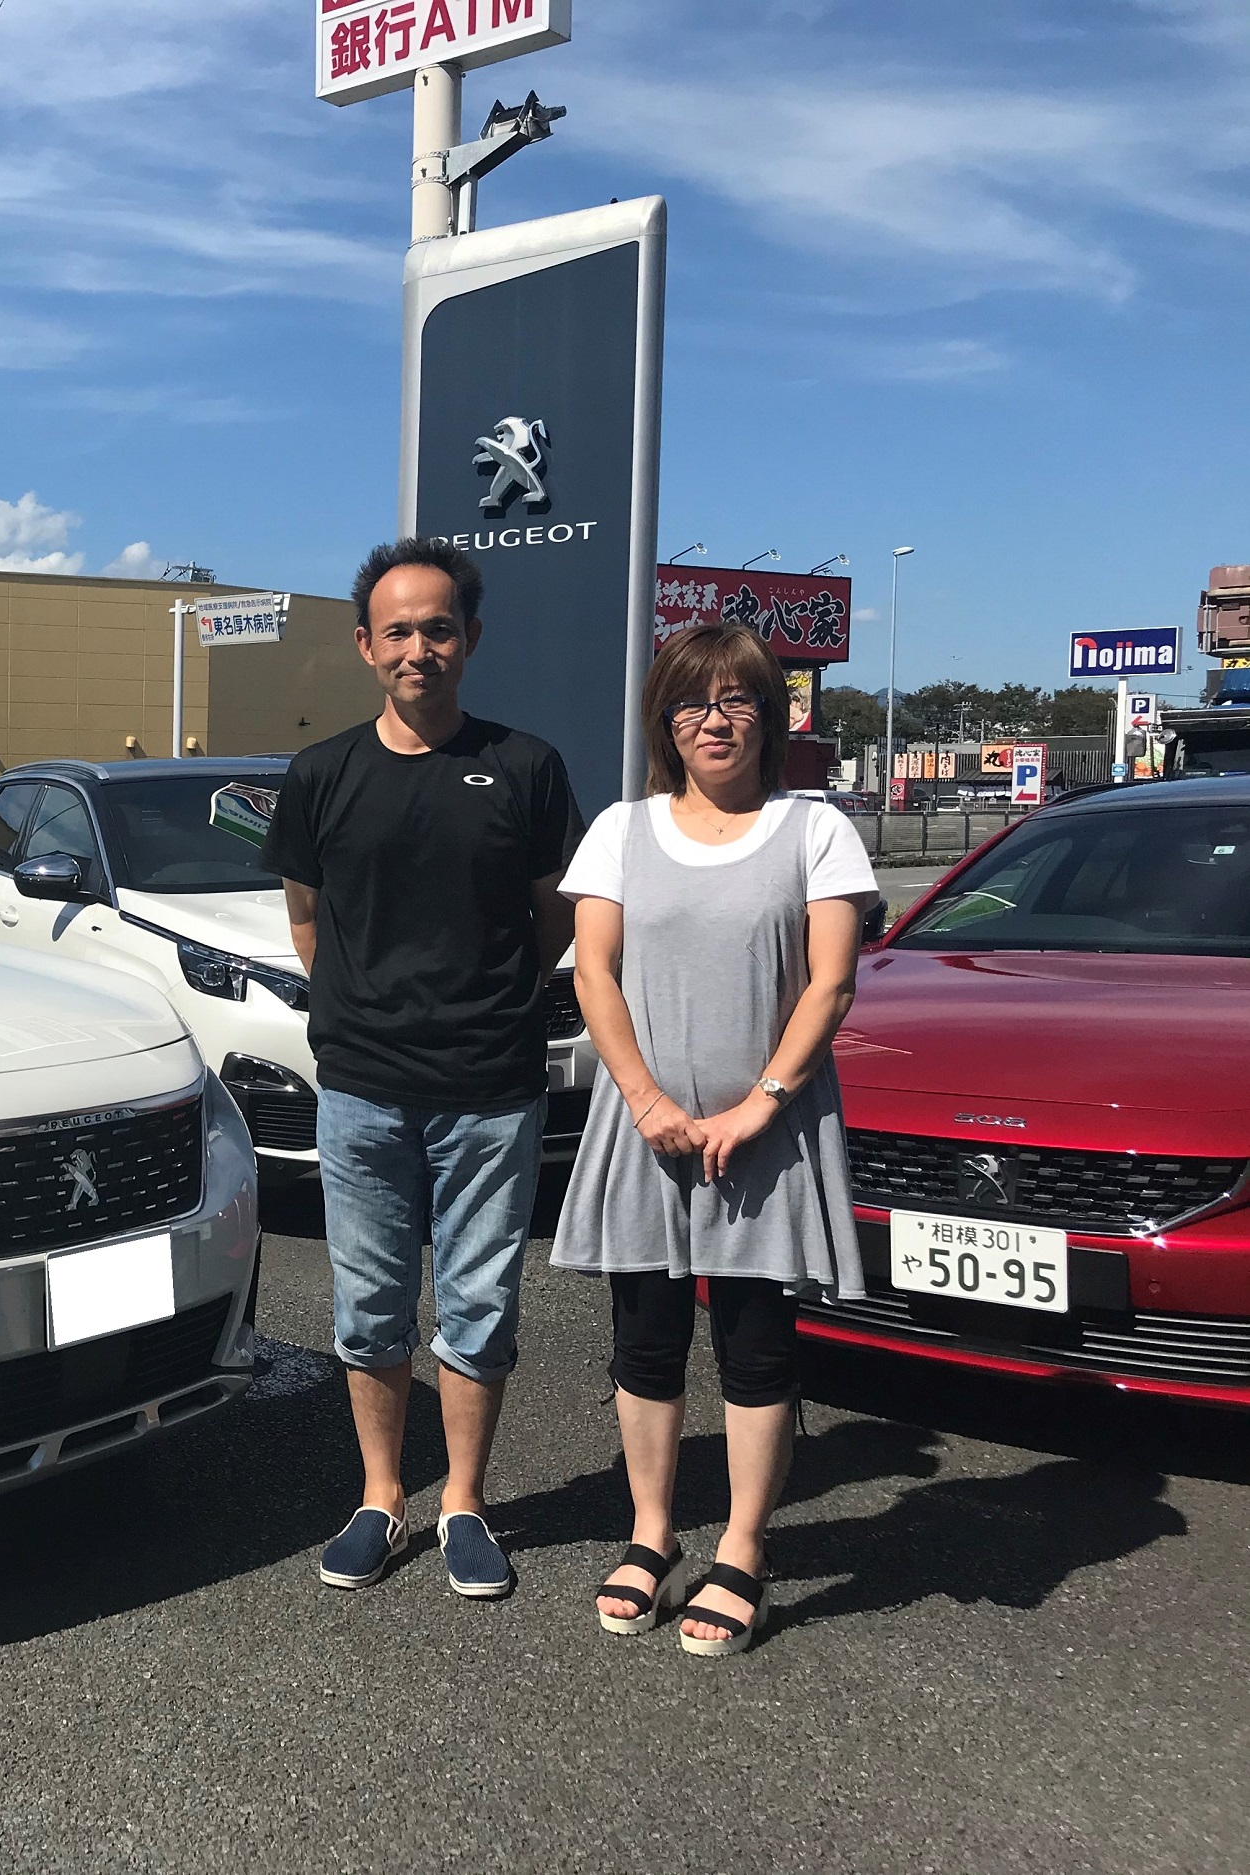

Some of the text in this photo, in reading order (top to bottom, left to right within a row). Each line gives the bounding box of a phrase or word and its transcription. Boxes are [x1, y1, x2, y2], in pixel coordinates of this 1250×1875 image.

[769, 587, 805, 596] こんしんや
[213, 613, 274, 636] 東名厚木病院
[1135, 700, 1146, 712] P
[1017, 765, 1037, 786] P
[51, 1110, 122, 1130] PEUGEOT
[901, 1248, 1056, 1303] や 50-95
